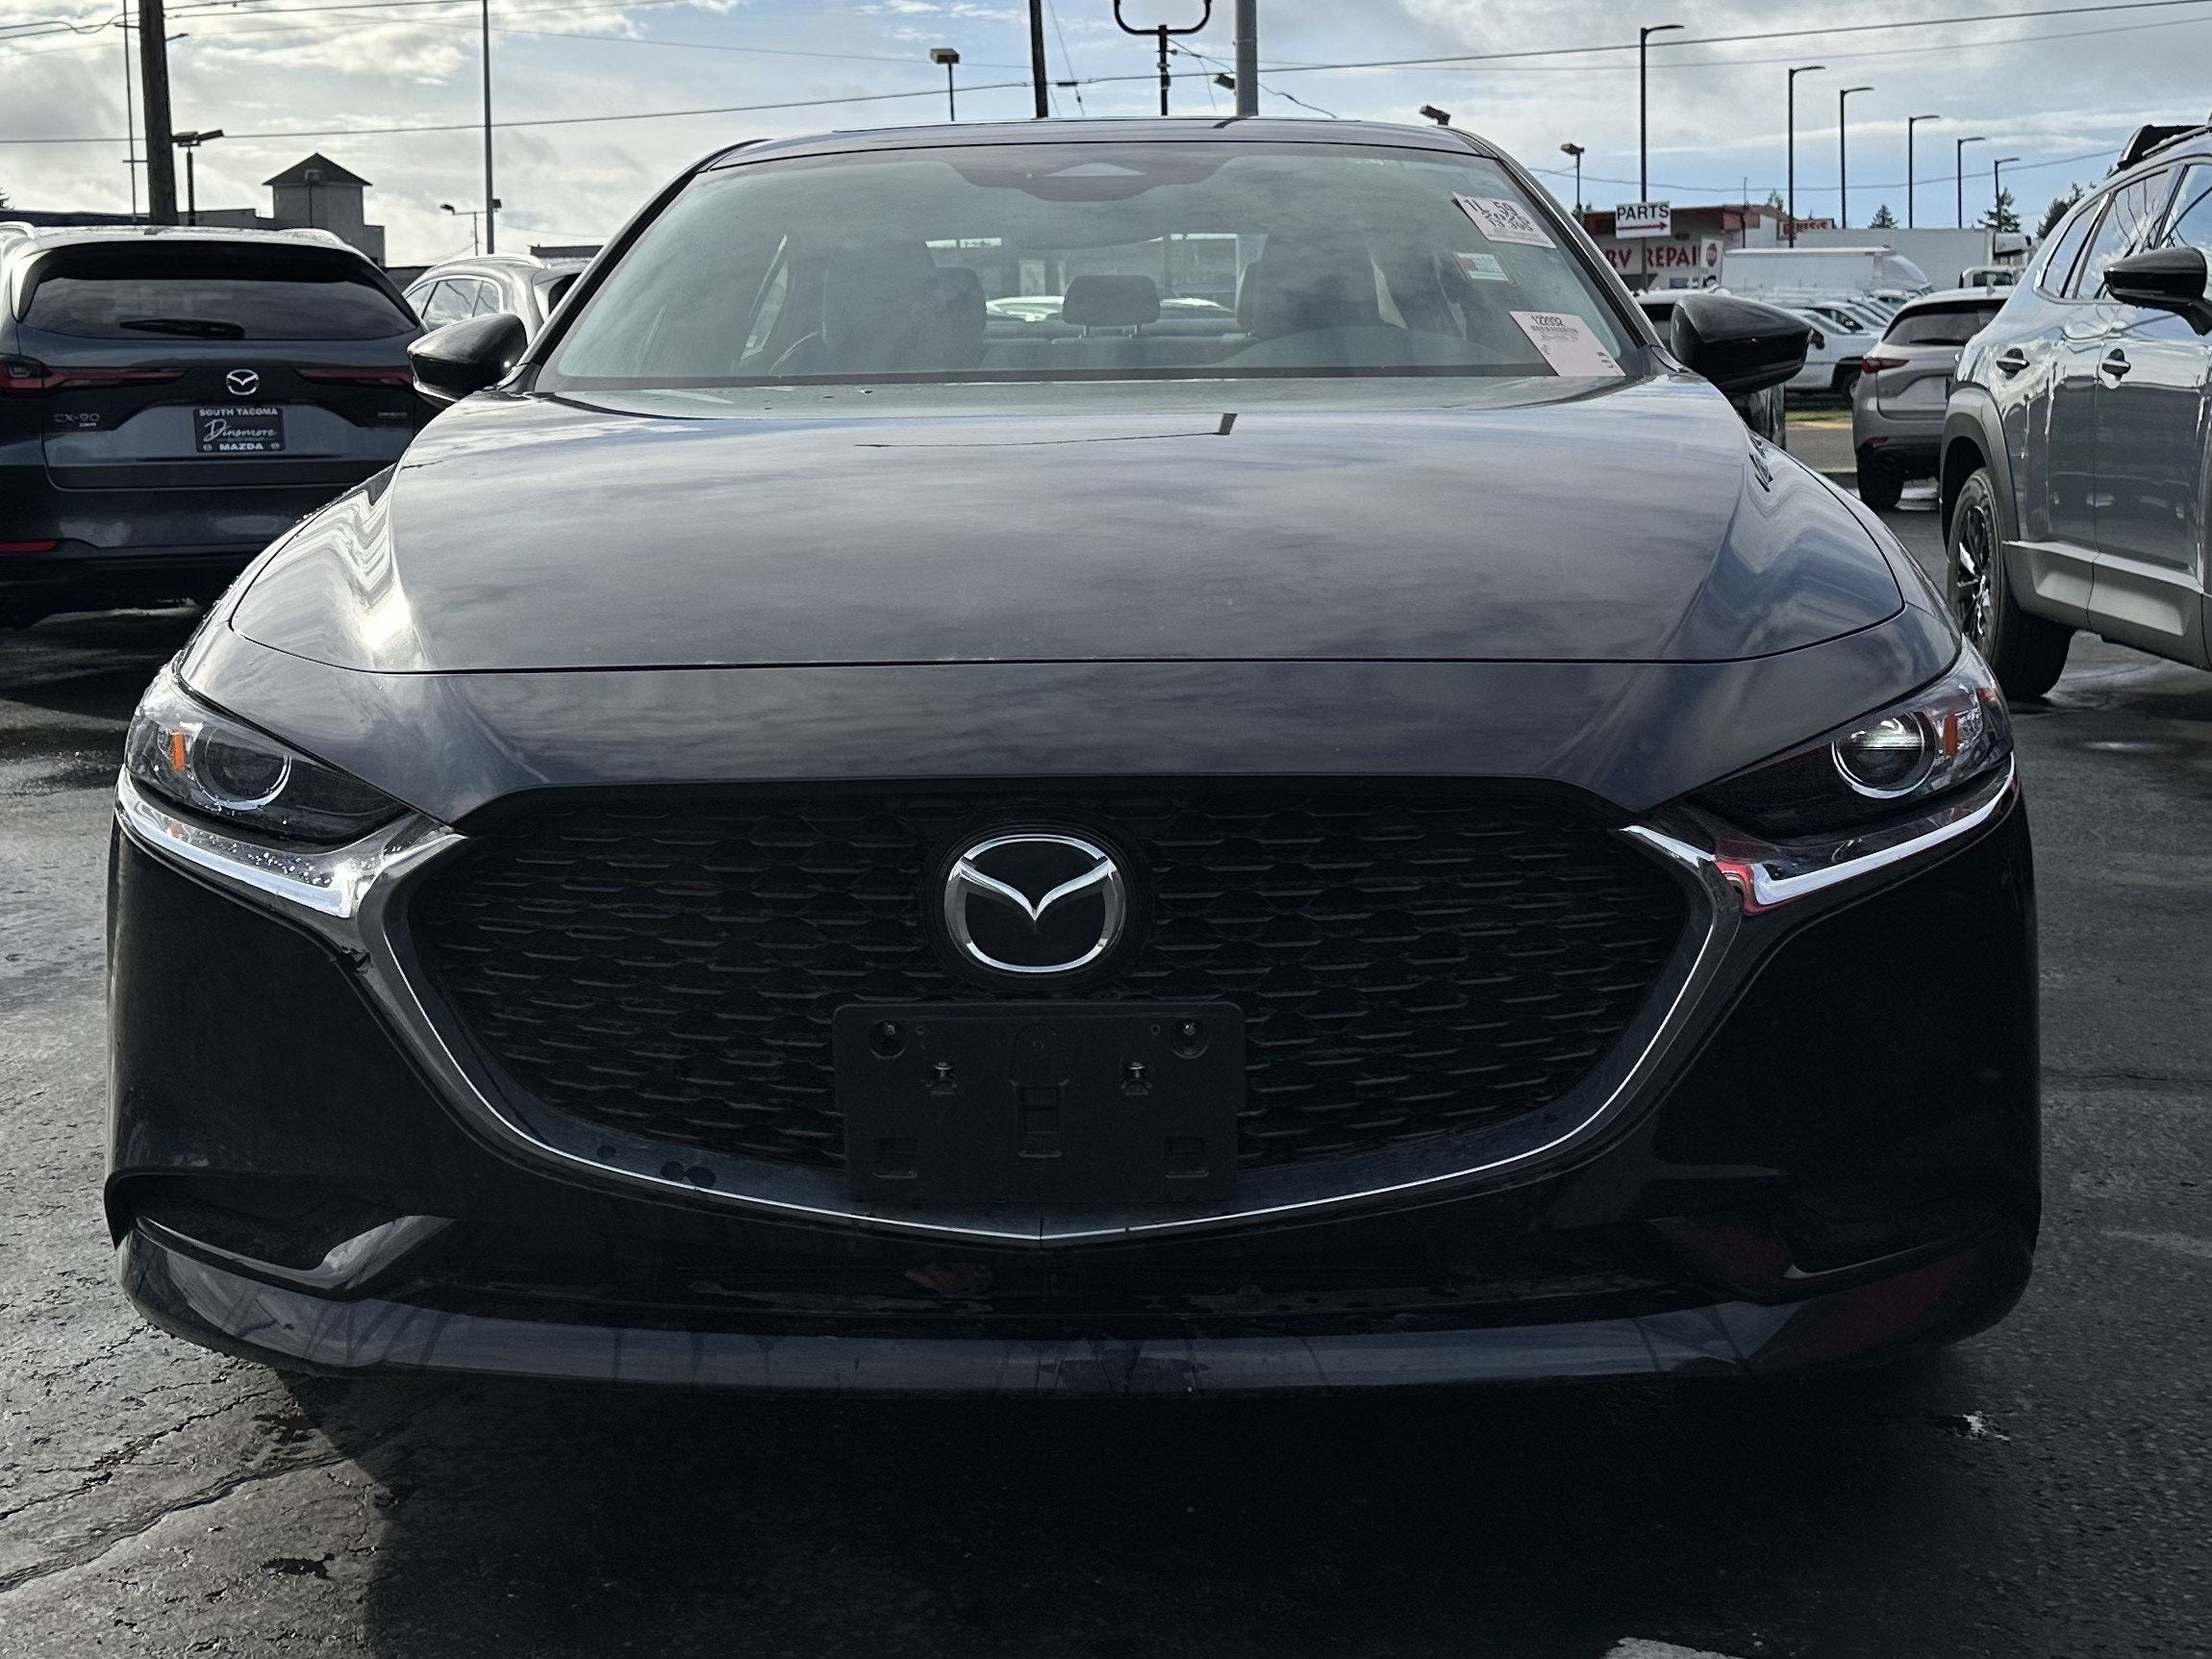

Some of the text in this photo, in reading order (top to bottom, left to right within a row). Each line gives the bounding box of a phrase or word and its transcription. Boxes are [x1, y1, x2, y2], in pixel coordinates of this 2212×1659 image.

[1617, 204, 1670, 221] PARTS
[1605, 246, 1632, 268] RV
[219, 442, 264, 451] MAZDA
